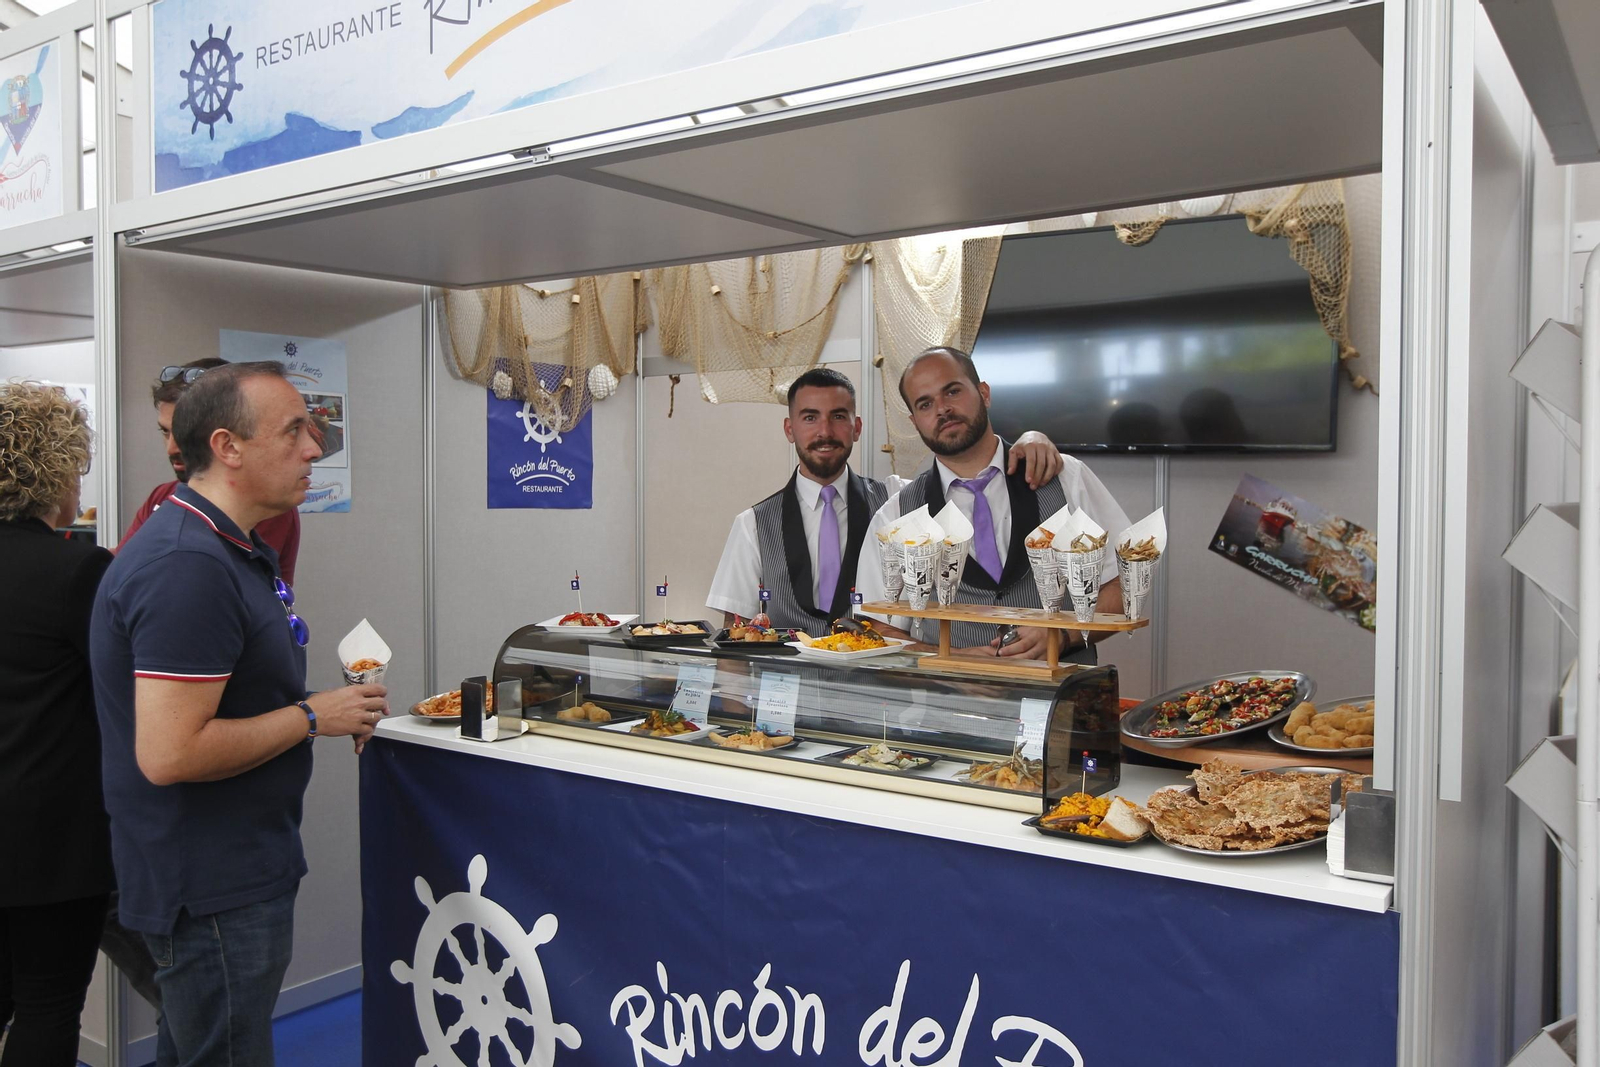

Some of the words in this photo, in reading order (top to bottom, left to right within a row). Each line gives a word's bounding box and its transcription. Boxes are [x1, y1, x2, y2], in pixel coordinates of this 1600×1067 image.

[256, 2, 402, 69] RESTAURANTE
[0, 172, 42, 211] arrucha
[300, 362, 323, 379] Puerto
[509, 460, 536, 480] Rincón
[537, 457, 549, 471] del
[549, 460, 576, 481] Puerto
[522, 485, 563, 493] RESTAURANTE
[1245, 546, 1319, 585] GARRUCHA
[610, 961, 826, 1067] Rincón
[858, 959, 980, 1067] del
